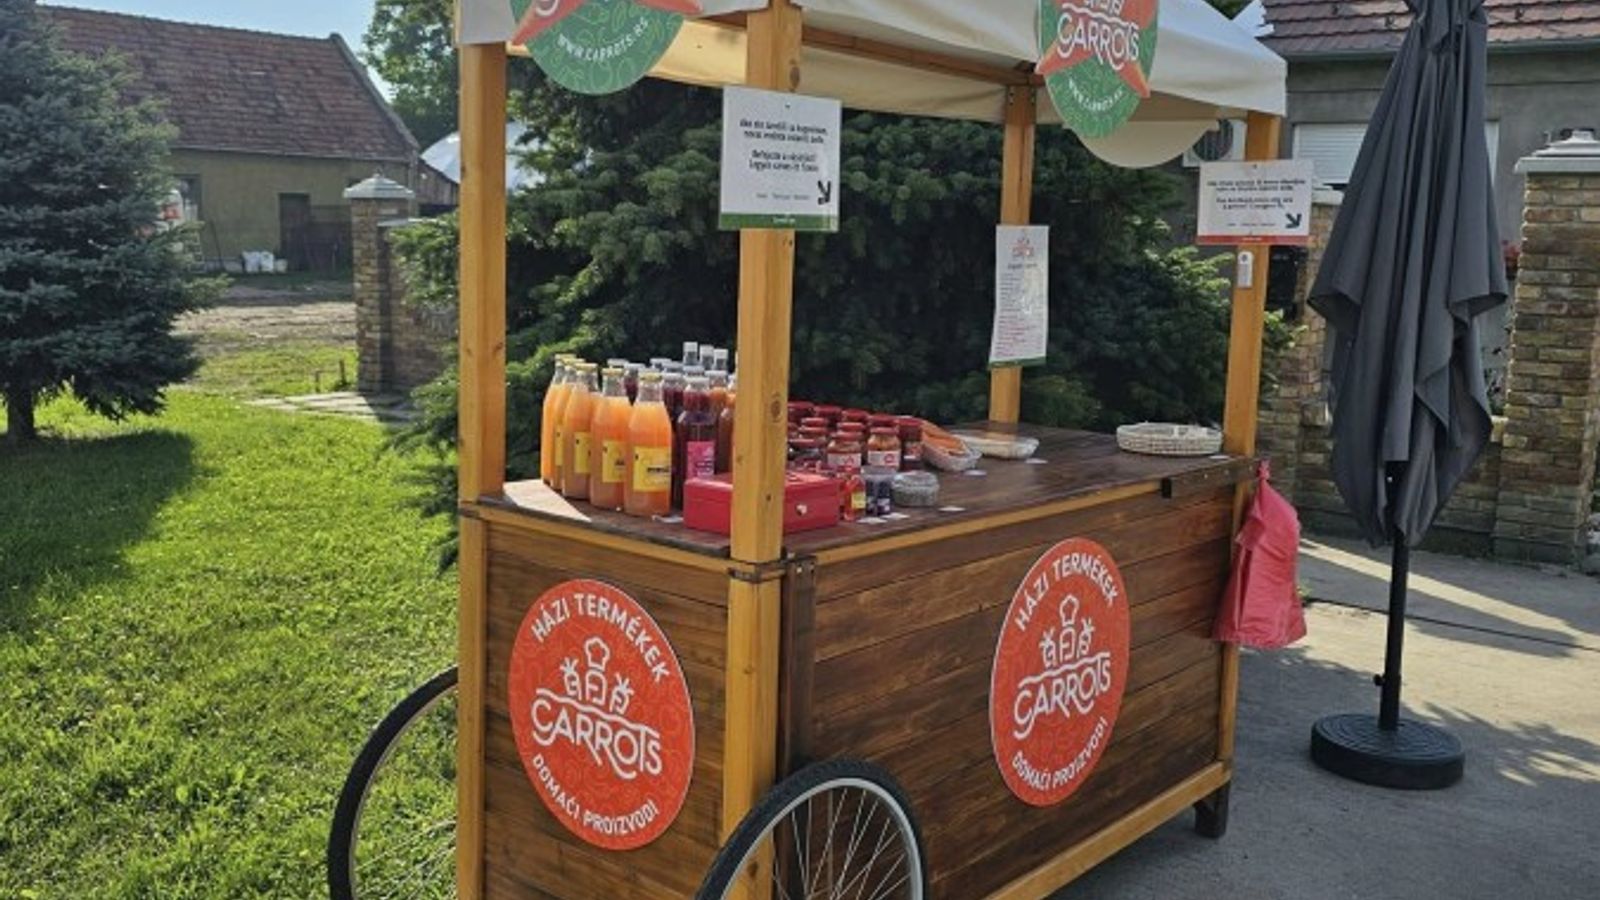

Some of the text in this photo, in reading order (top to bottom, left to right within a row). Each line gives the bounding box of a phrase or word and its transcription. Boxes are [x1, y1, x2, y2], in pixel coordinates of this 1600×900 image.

[1057, 13, 1140, 71] CARROTS
[1015, 552, 1119, 631] HÁZI TERMÉKEK
[532, 593, 669, 683] HÁZI TERMÉKEK
[1013, 652, 1112, 741] CARROTS
[532, 698, 662, 779] CARROTS
[1011, 716, 1109, 792] DOMAĆI PROIZVODI
[533, 753, 659, 836] DOMAĆI PROIZVODI
